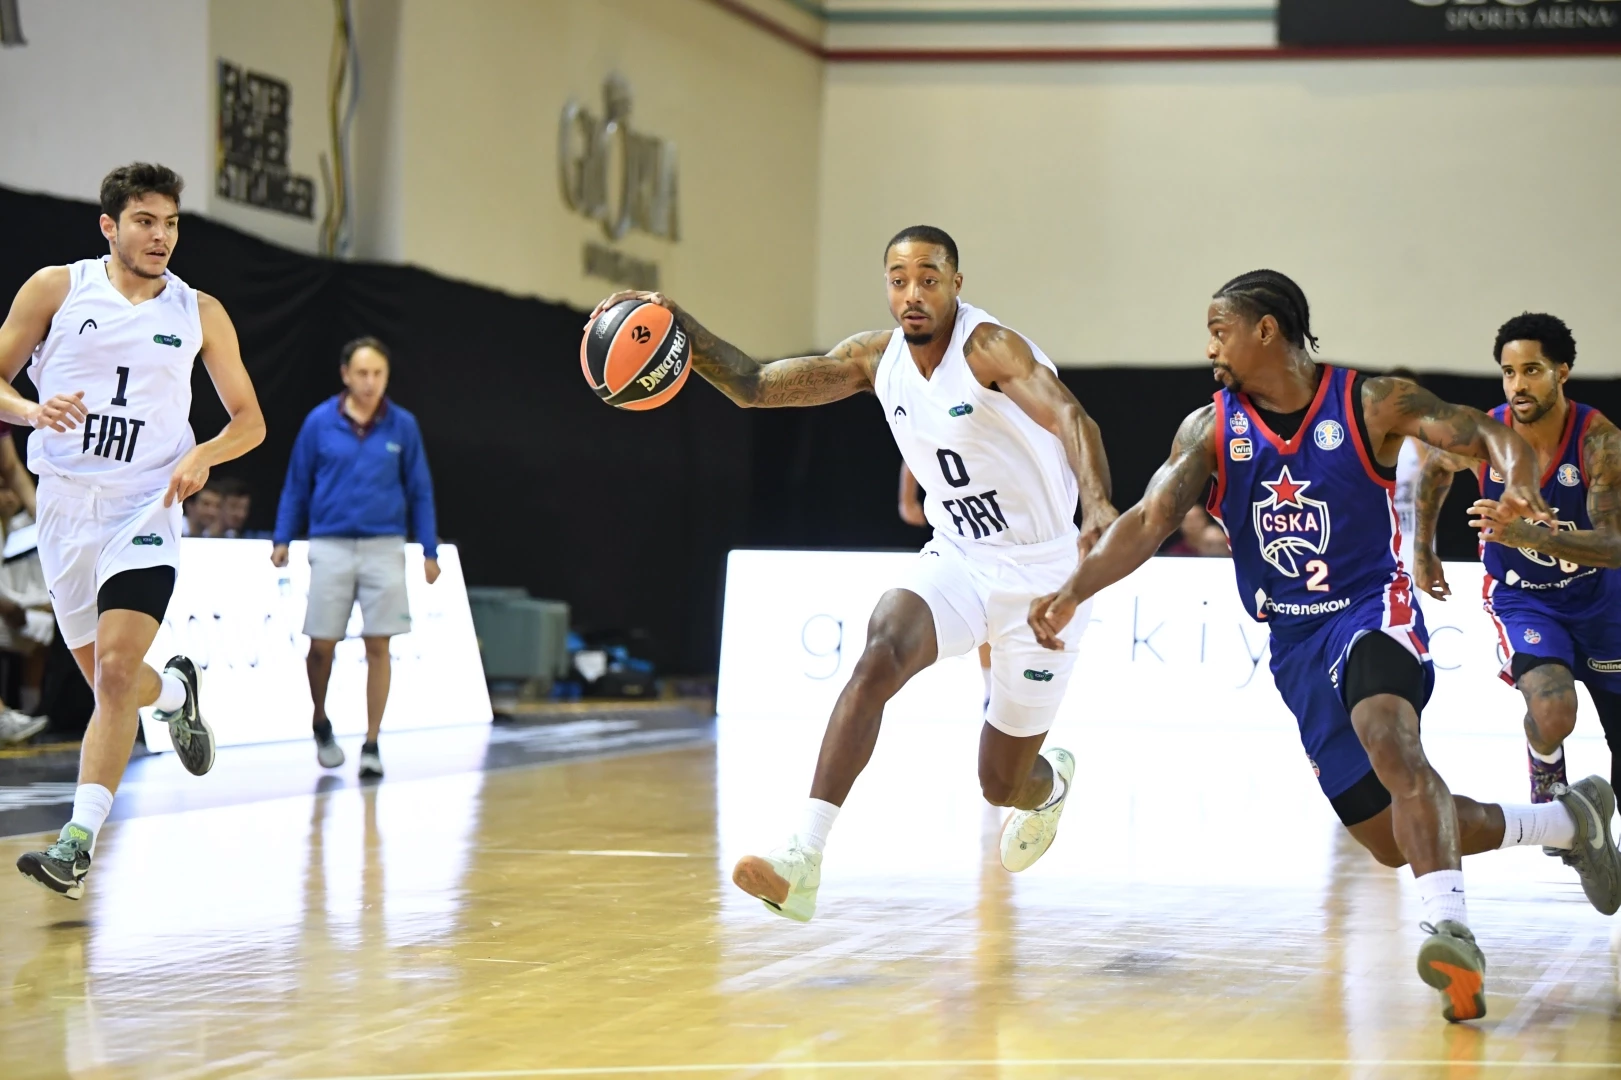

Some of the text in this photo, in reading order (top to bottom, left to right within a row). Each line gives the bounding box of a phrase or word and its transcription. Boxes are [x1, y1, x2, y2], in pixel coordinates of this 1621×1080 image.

[1445, 5, 1619, 31] SPORTS ARENA
[110, 366, 130, 406] 1
[82, 413, 146, 463] FIAT
[936, 448, 971, 488] 0
[942, 490, 1010, 540] FIAT
[1262, 512, 1319, 533] CSKA
[1305, 559, 1330, 592] 2
